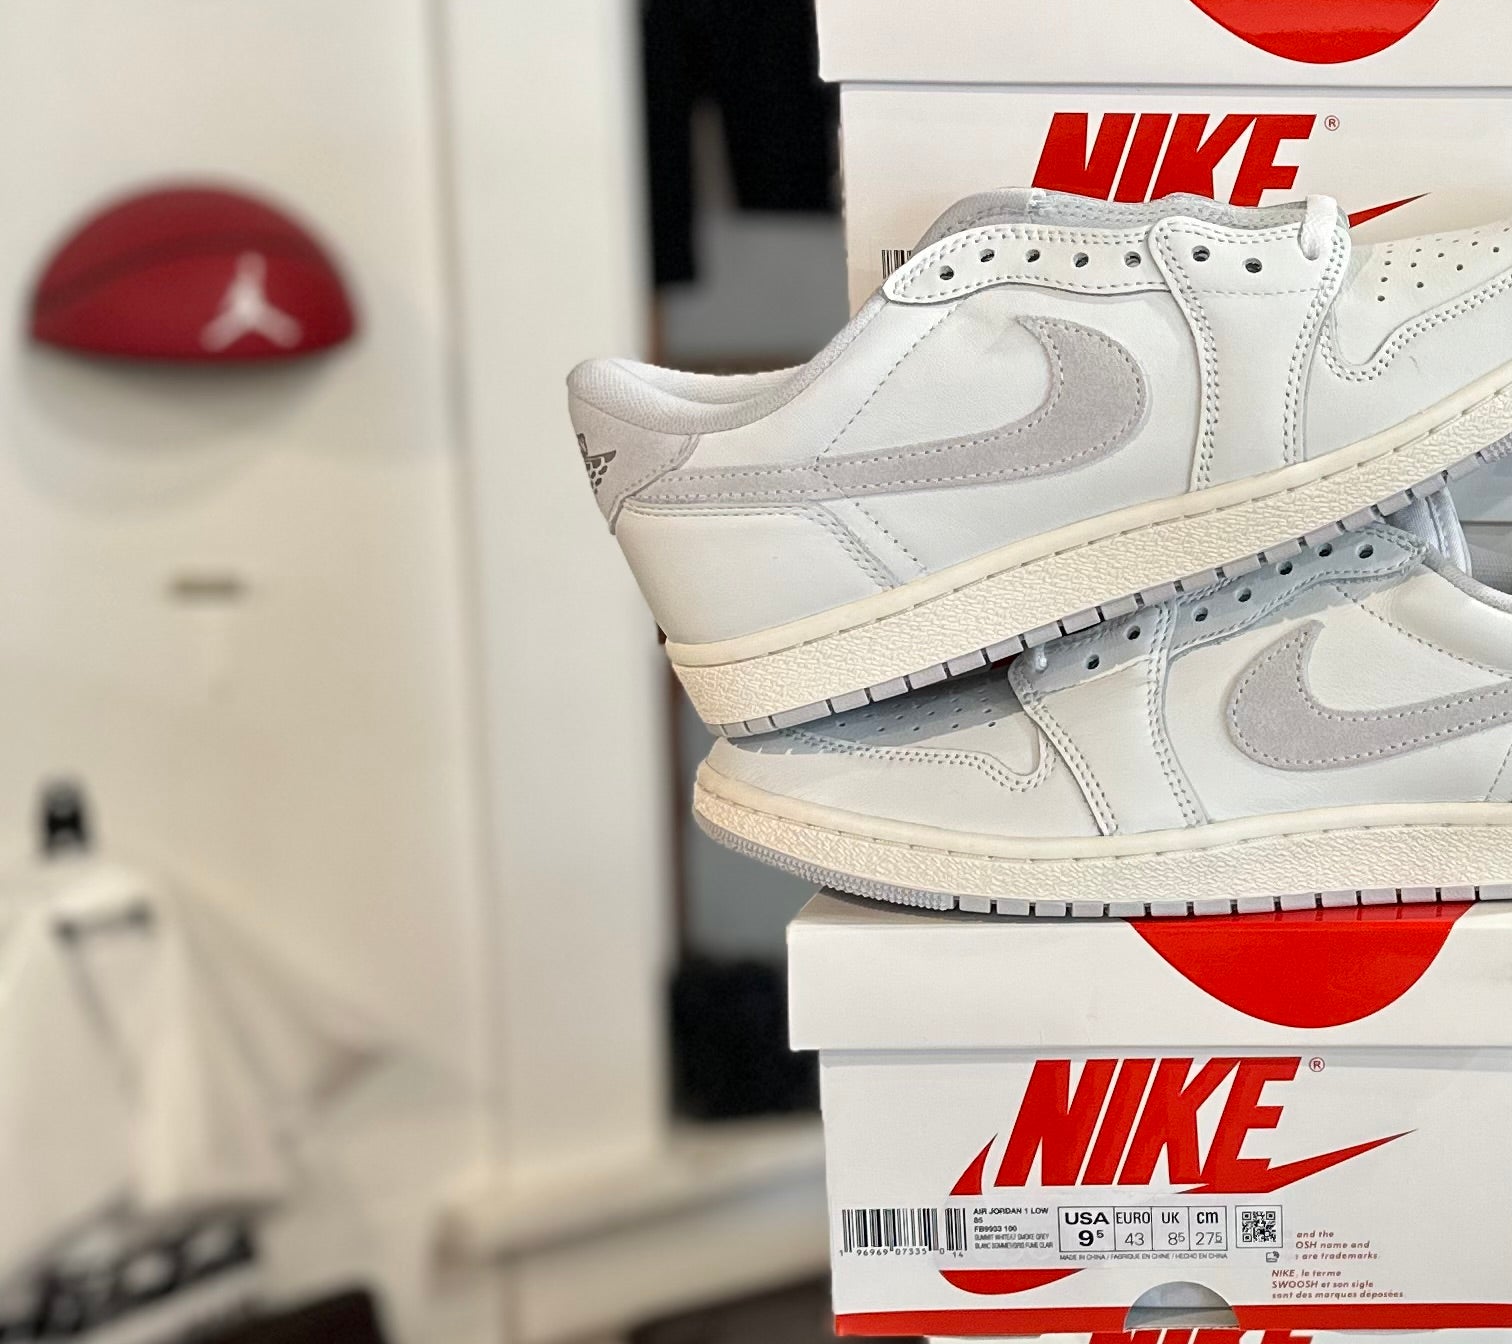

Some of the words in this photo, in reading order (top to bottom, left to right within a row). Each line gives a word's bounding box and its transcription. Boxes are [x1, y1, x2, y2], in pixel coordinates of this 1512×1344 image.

[994, 1057, 1301, 1187] NIKE
[1065, 1212, 1109, 1224] USA
[1116, 1212, 1150, 1224] EURO
[1162, 1212, 1179, 1224] UK
[1197, 1212, 1218, 1224] cm
[1125, 1233, 1144, 1245] 43
[1352, 1281, 1373, 1289] sigle
[1315, 1292, 1357, 1300] marques
